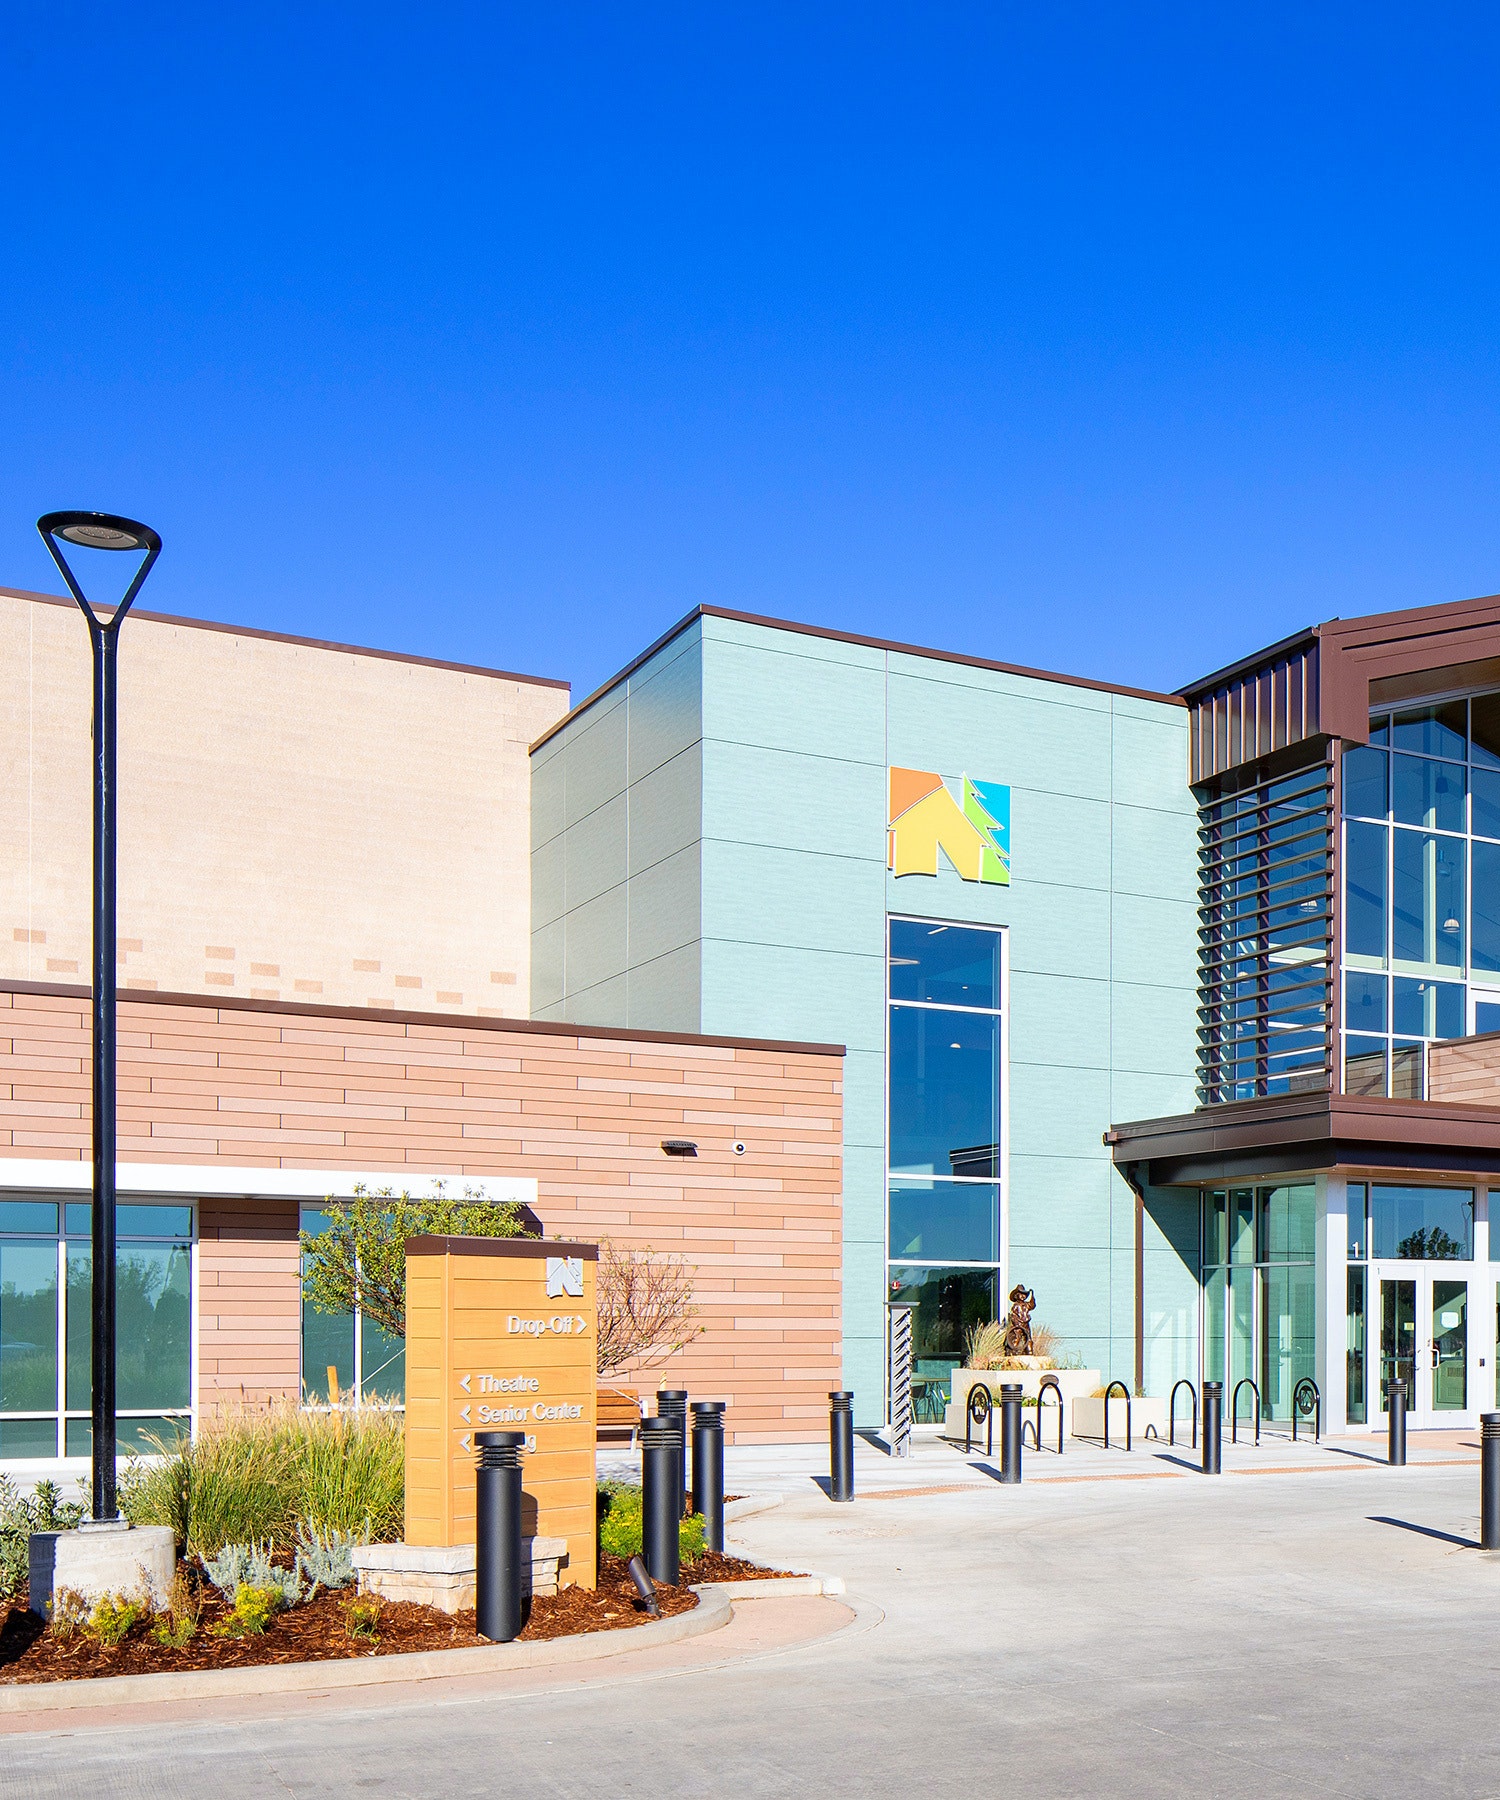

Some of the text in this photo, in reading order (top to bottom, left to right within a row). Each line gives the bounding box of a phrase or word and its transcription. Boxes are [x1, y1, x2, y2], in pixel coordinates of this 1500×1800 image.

[1351, 1241, 1359, 1258] 1
[508, 1315, 574, 1337] Drop-Off
[478, 1374, 539, 1392] Theatre
[478, 1402, 583, 1423] Senior Center
